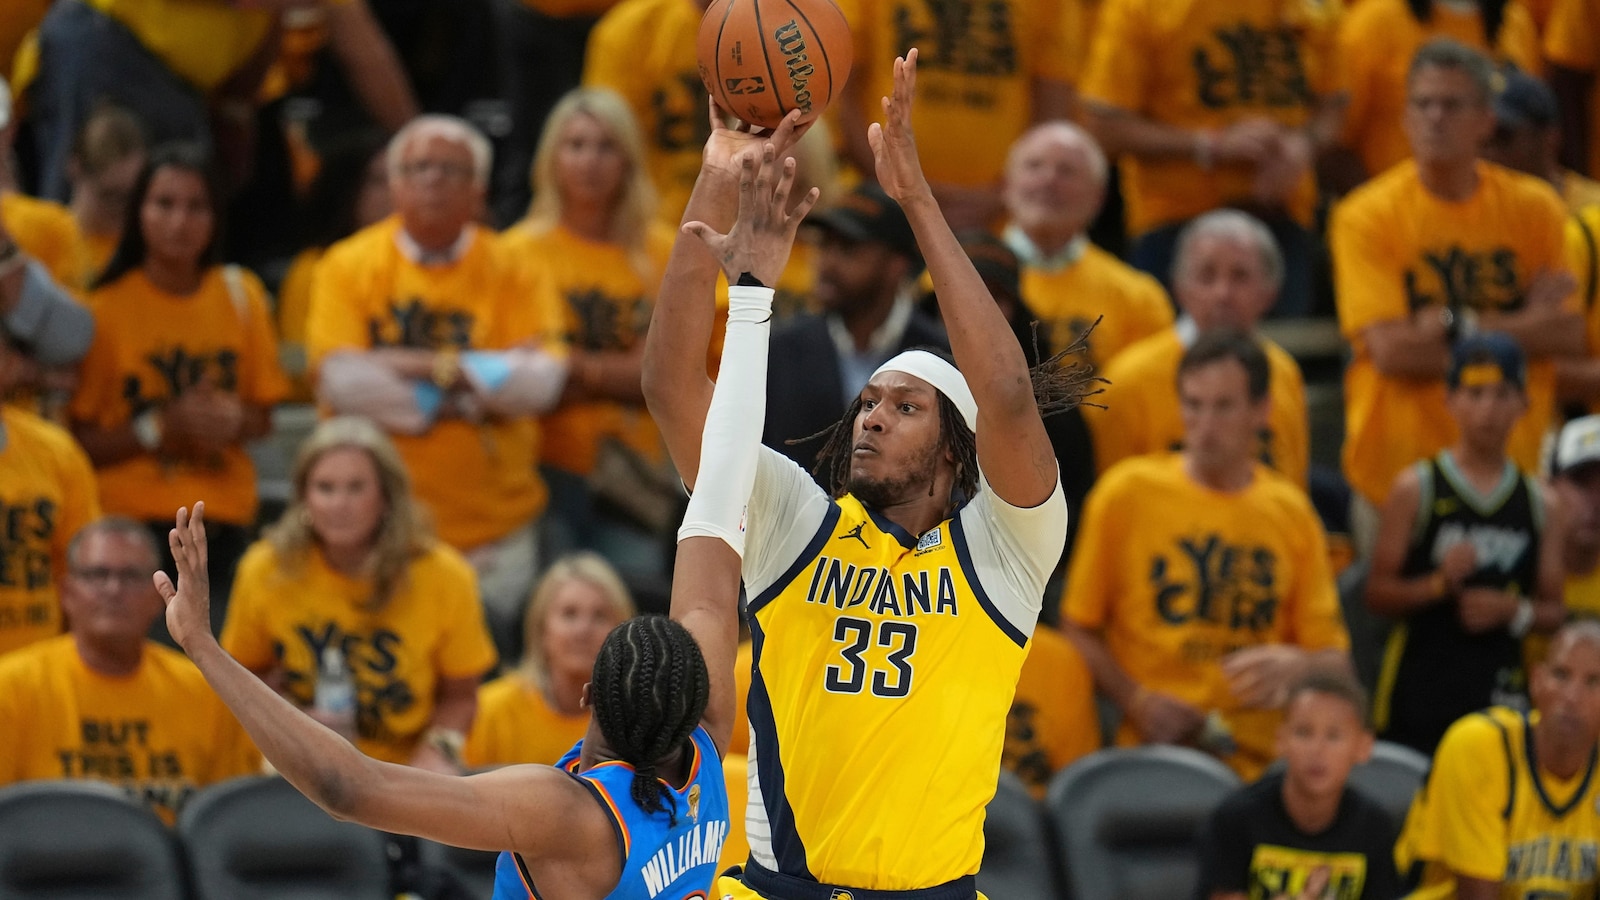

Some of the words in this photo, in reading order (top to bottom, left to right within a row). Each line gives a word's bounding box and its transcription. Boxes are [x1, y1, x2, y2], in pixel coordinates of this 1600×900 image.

[774, 19, 814, 116] Wilson
[806, 556, 958, 618] INDIANA
[1178, 533, 1276, 614] YES
[824, 616, 919, 698] 33
[82, 721, 149, 746] BUT
[641, 819, 727, 899] WILLIAMS
